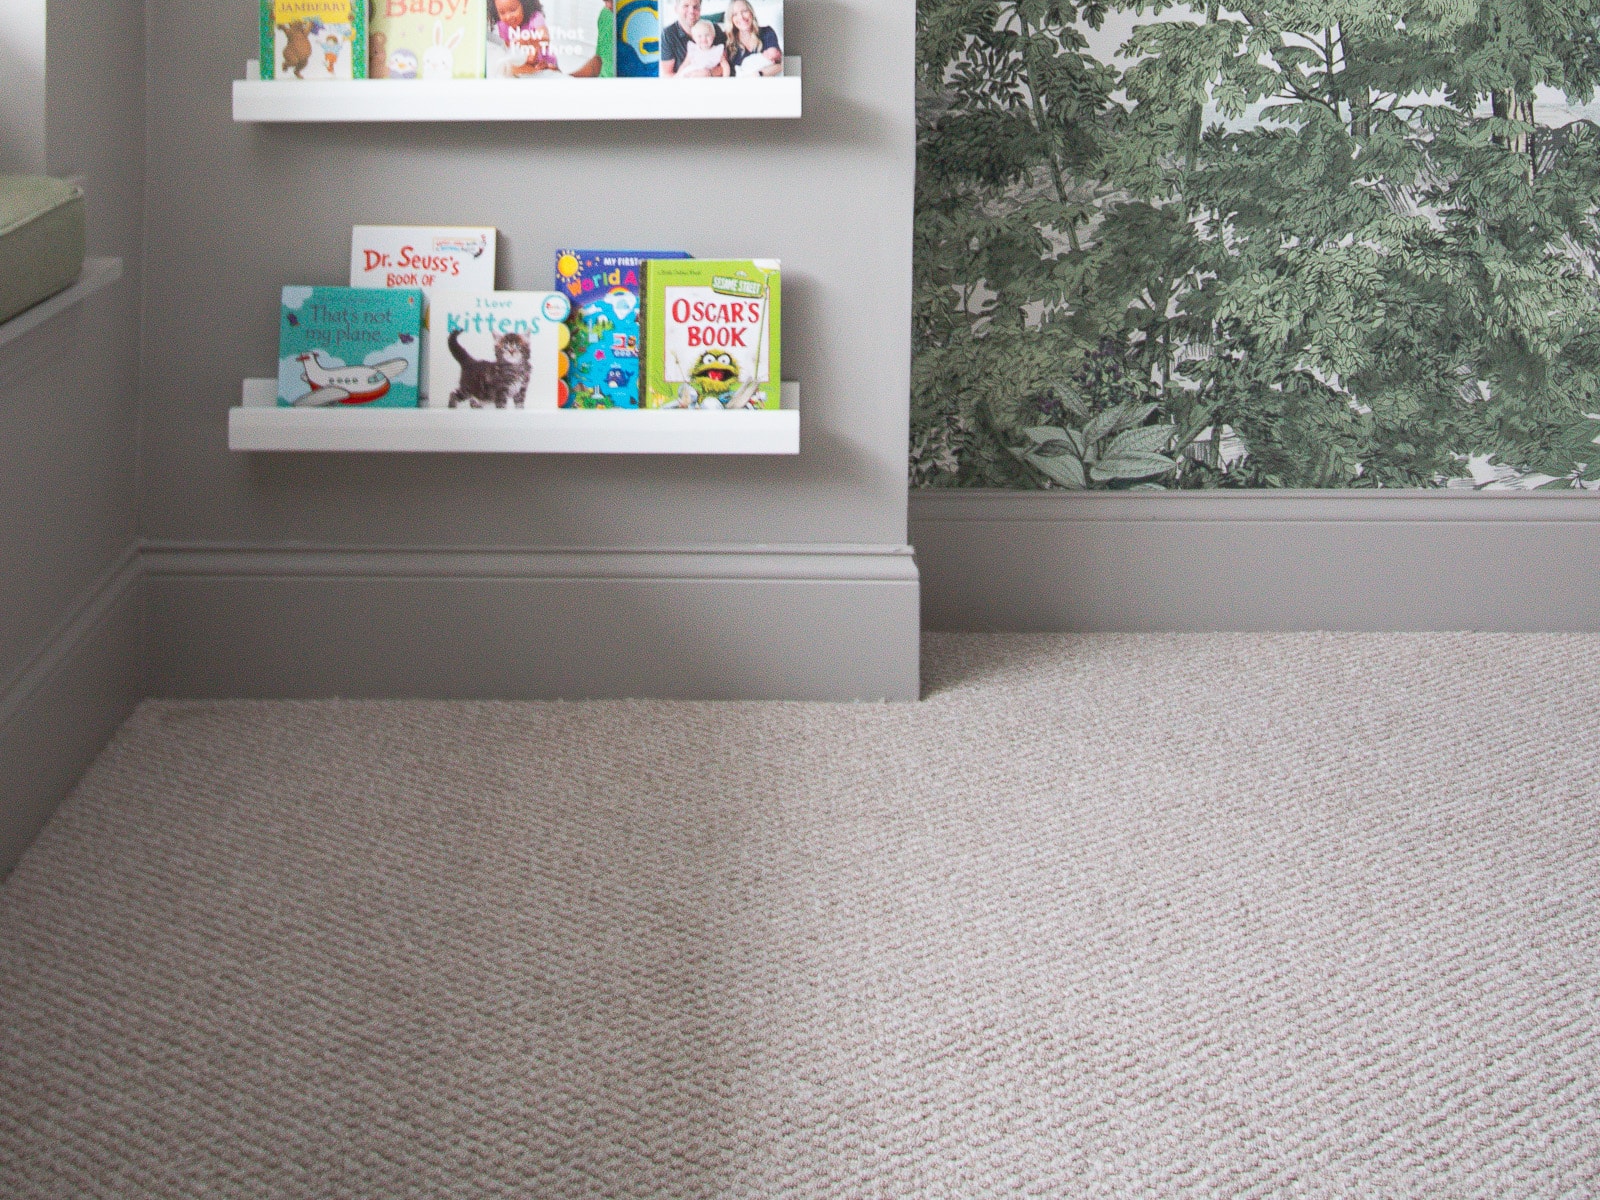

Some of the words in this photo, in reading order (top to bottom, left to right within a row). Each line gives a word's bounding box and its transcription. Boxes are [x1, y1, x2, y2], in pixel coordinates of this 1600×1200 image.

[280, 2, 346, 13] JAMBERRY
[508, 25, 544, 41] Now
[548, 25, 585, 40] That
[538, 41, 583, 56] Three
[363, 249, 392, 272] Dr.
[397, 245, 460, 276] Seuss's
[603, 257, 616, 266] MY
[617, 257, 639, 266] FIRST
[386, 272, 418, 288] BOOK
[421, 273, 436, 287] OF
[567, 267, 621, 298] World
[475, 298, 481, 308] I
[672, 298, 760, 324] OSCAR'S
[310, 304, 358, 323] That's
[363, 308, 393, 323] not
[305, 328, 333, 347] my
[687, 326, 748, 348] BOOK
